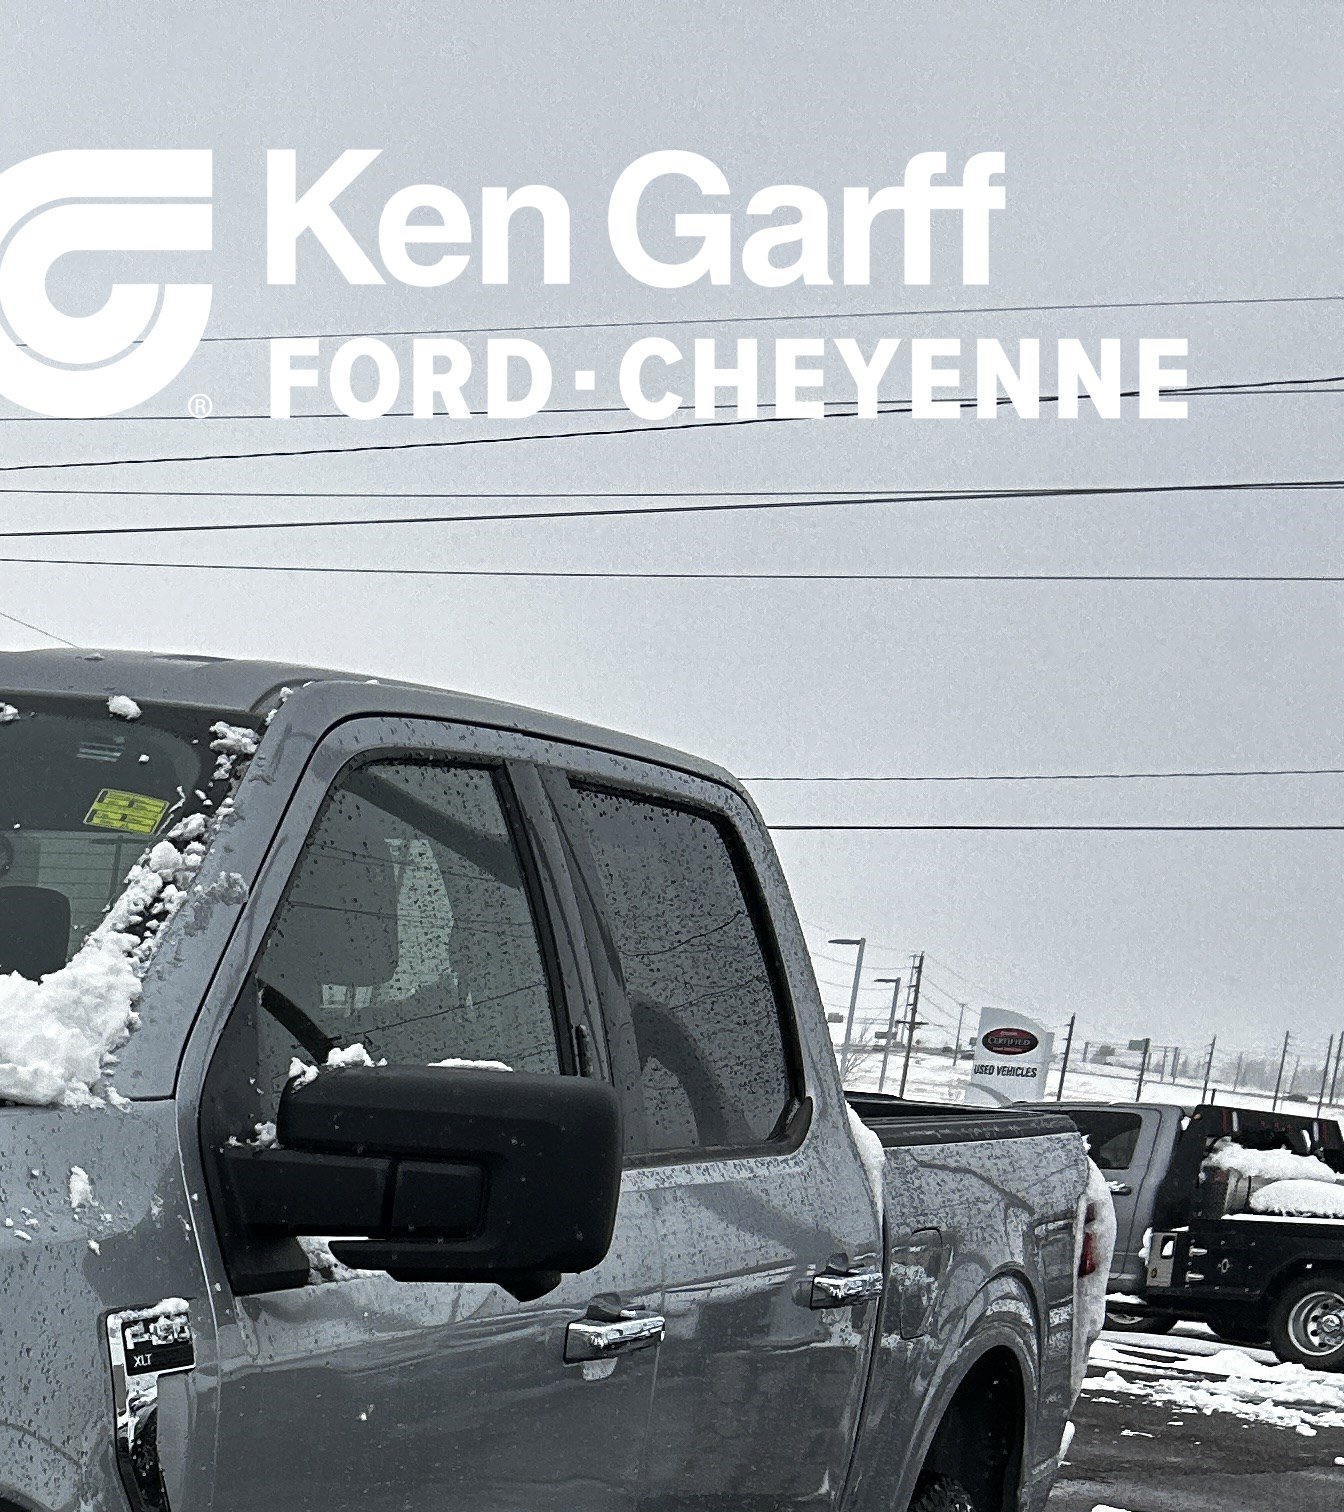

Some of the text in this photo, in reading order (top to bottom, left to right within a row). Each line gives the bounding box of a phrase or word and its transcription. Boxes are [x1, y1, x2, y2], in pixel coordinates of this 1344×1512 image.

[974, 1064, 1038, 1078] USED VEHICLES
[133, 1353, 153, 1368] XLT
